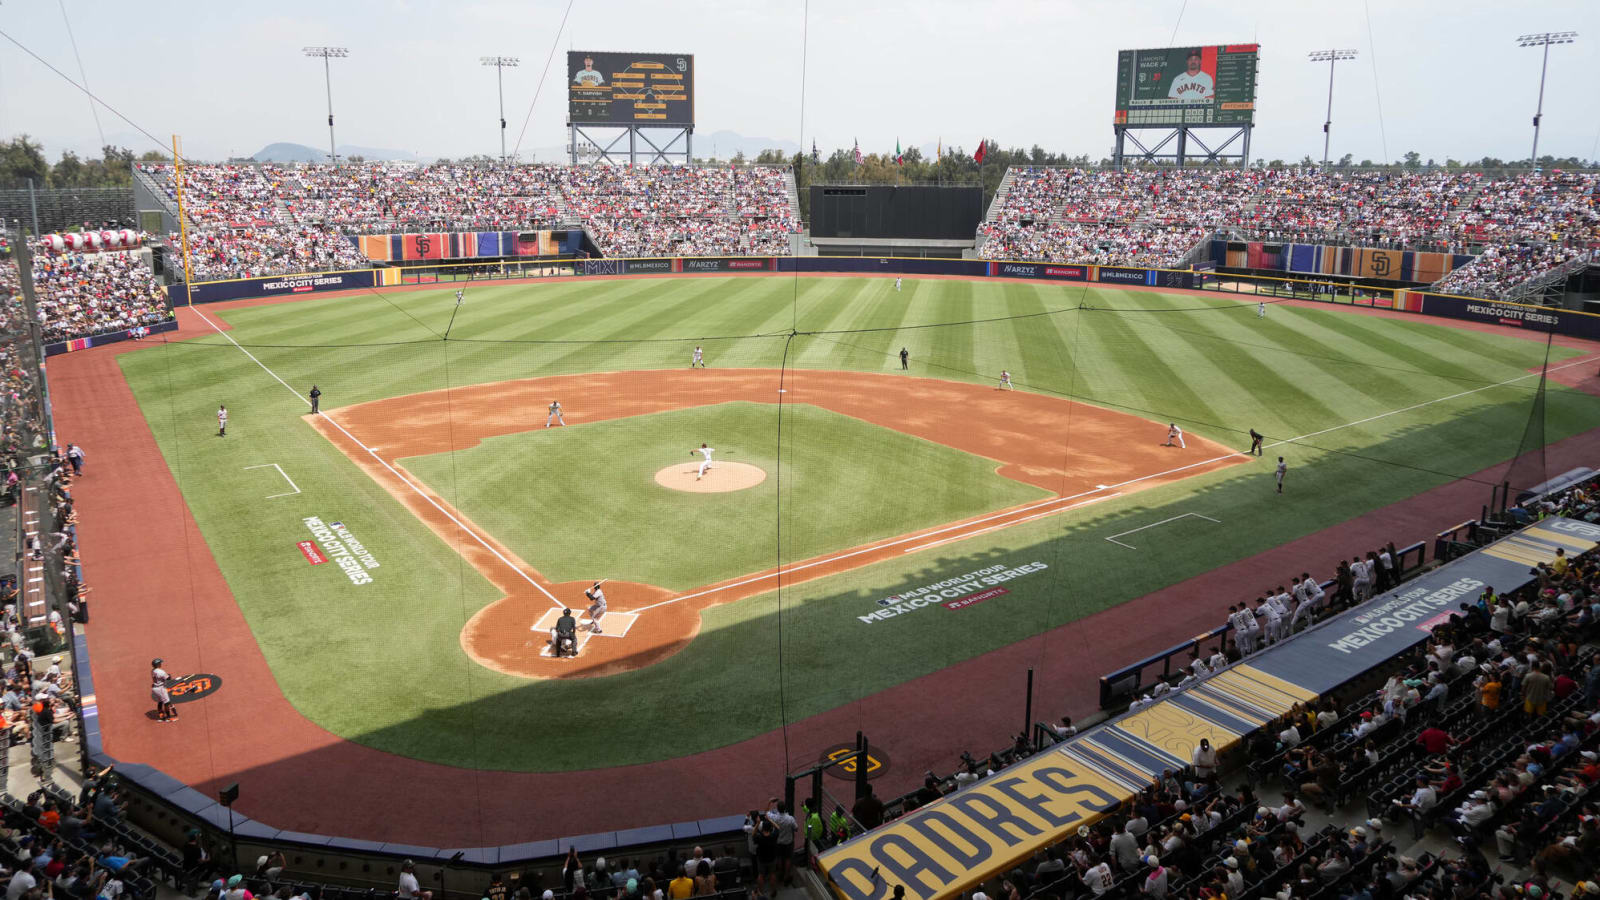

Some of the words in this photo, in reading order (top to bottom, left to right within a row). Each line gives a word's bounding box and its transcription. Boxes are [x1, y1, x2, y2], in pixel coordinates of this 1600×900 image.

[1176, 83, 1206, 95] GIANTS
[416, 235, 431, 257] SF
[1371, 251, 1390, 276] SD
[263, 280, 295, 290] MEXICO
[296, 279, 313, 287] CITY
[314, 276, 342, 286] SERIES
[1466, 304, 1503, 317] MEXICO
[1504, 309, 1523, 319] CITY
[1524, 312, 1559, 325] SERIES
[302, 516, 337, 542] MEXICO
[322, 541, 350, 557] CITY
[335, 556, 374, 585] SERIES
[898, 587, 931, 600] MLB
[926, 574, 975, 591] WORLD
[972, 564, 1007, 577] TOUR
[856, 594, 943, 624] MEXICO
[940, 580, 984, 598] CITY
[981, 561, 1049, 585] SERIES
[961, 588, 1005, 605] BANORTE
[1363, 608, 1386, 620] MLB
[1382, 596, 1411, 612] WORLD
[1403, 587, 1430, 599] TOUR
[1328, 617, 1405, 653] MEXICO
[1393, 600, 1437, 621] CITY
[1424, 577, 1485, 607] SERIES
[829, 766, 1126, 900] PADRES
